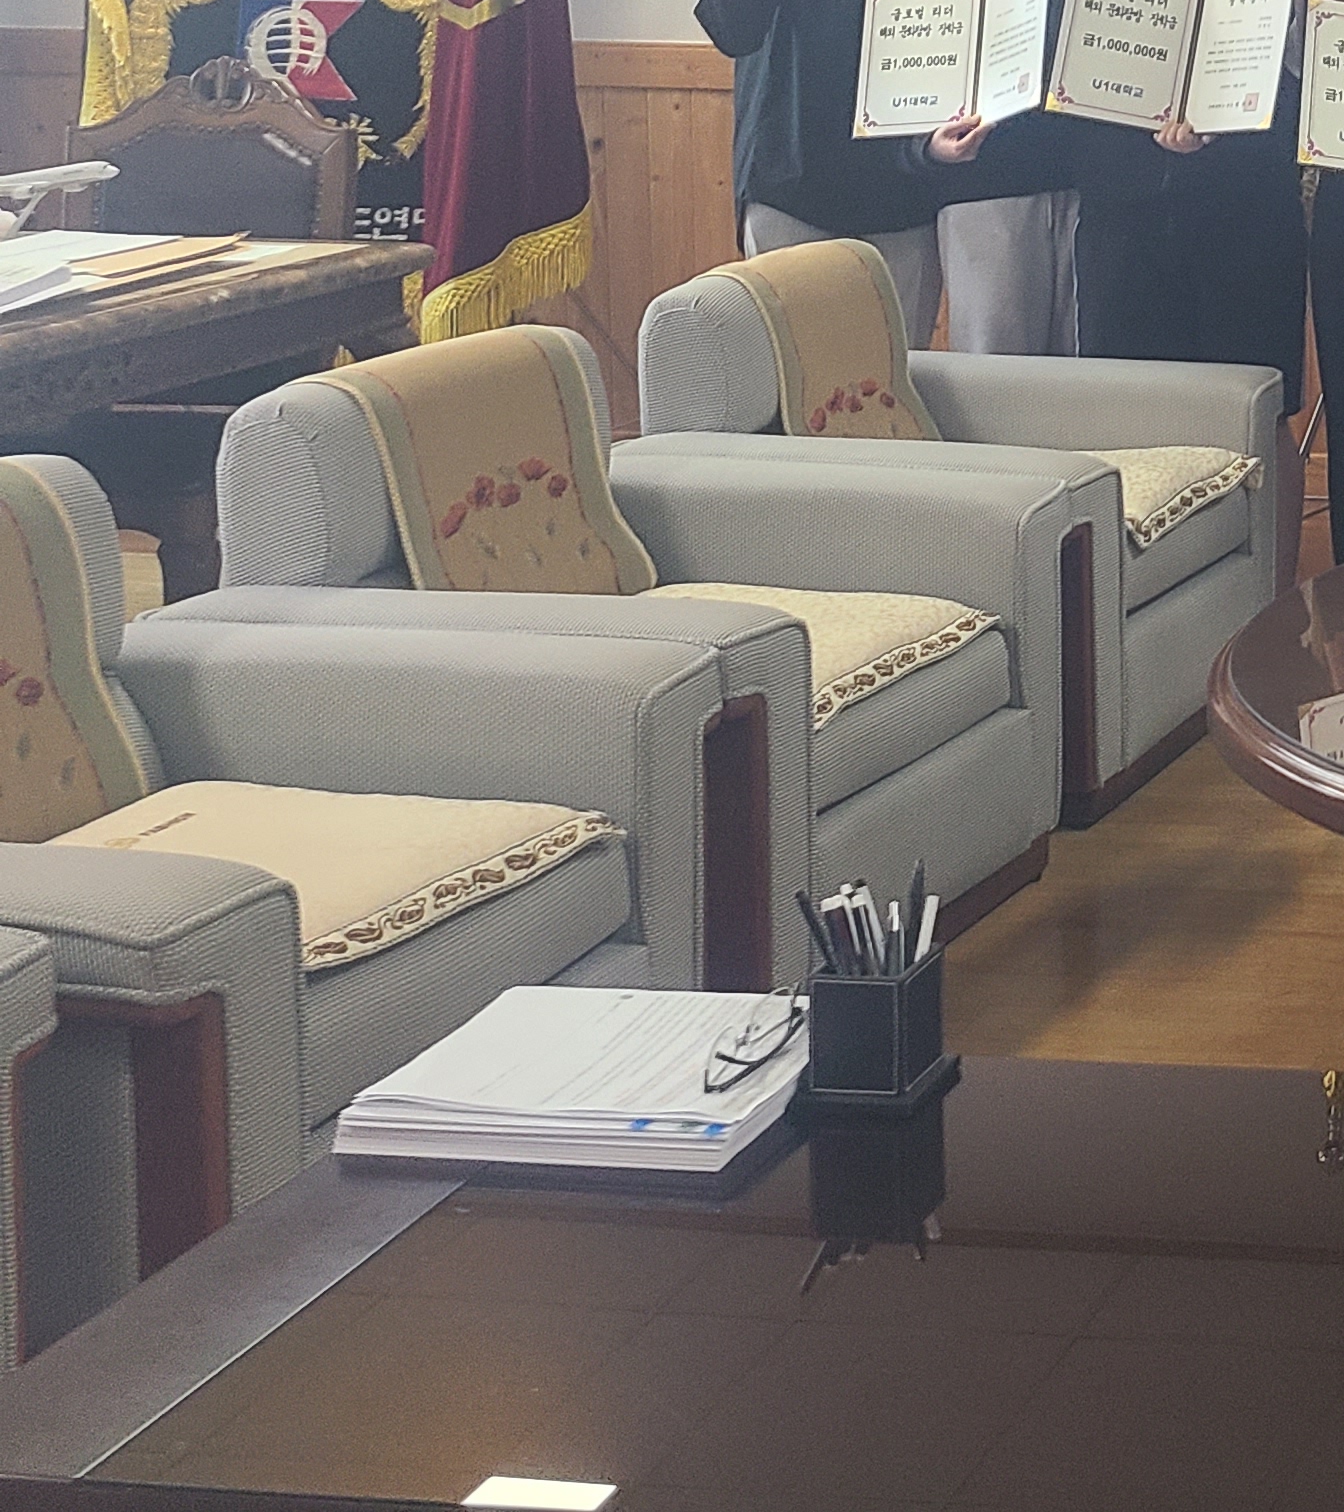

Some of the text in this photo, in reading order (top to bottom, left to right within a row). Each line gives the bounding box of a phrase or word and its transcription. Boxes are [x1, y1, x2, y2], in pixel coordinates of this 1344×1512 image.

[932, 4, 954, 18] 리더
[1083, 33, 1168, 61] 금1,000,000원
[881, 54, 957, 71] 금1,000,000원
